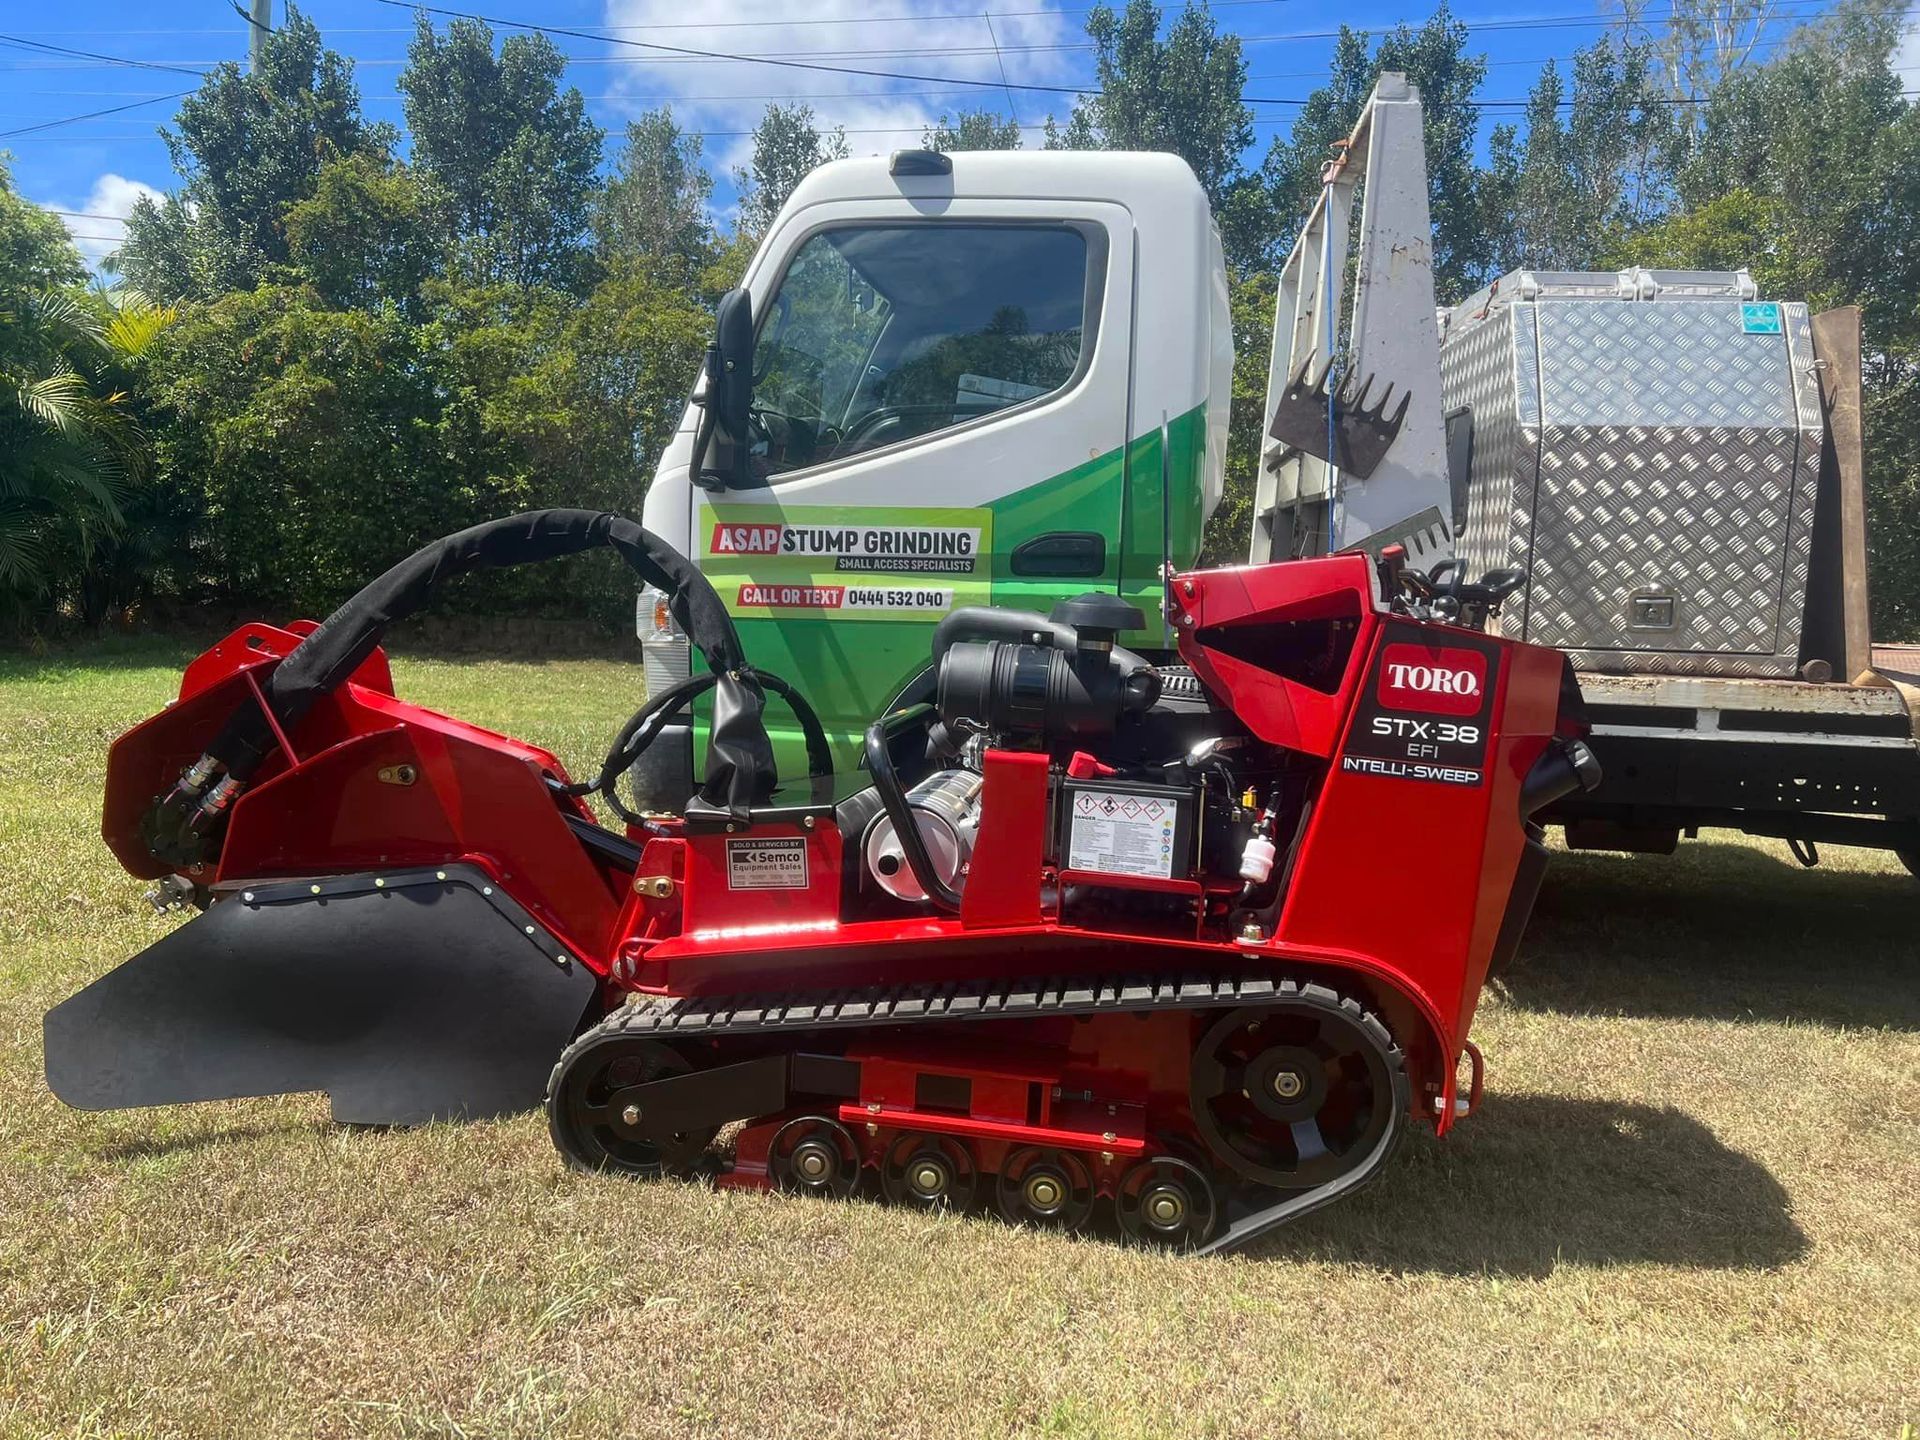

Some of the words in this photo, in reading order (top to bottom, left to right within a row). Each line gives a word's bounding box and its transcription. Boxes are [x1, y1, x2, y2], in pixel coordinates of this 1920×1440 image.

[719, 528, 778, 552] ASAP
[782, 529, 858, 553] STUMP
[864, 531, 972, 555] GRINDING
[839, 558, 872, 570] SMALL
[873, 559, 911, 571] ACCESS
[911, 560, 972, 572] SPECIALISTS
[743, 587, 779, 604] CALL
[781, 588, 801, 605] OR
[804, 589, 839, 605] TEXT
[849, 590, 884, 606] 0444
[887, 591, 913, 606] 532
[916, 592, 943, 606] 040
[1407, 743, 1439, 759] EFI
[1343, 757, 1479, 783] INTELLI-SWEEP
[759, 852, 800, 863] Semco
[733, 864, 777, 872] Equipment
[779, 863, 802, 871] Sales
